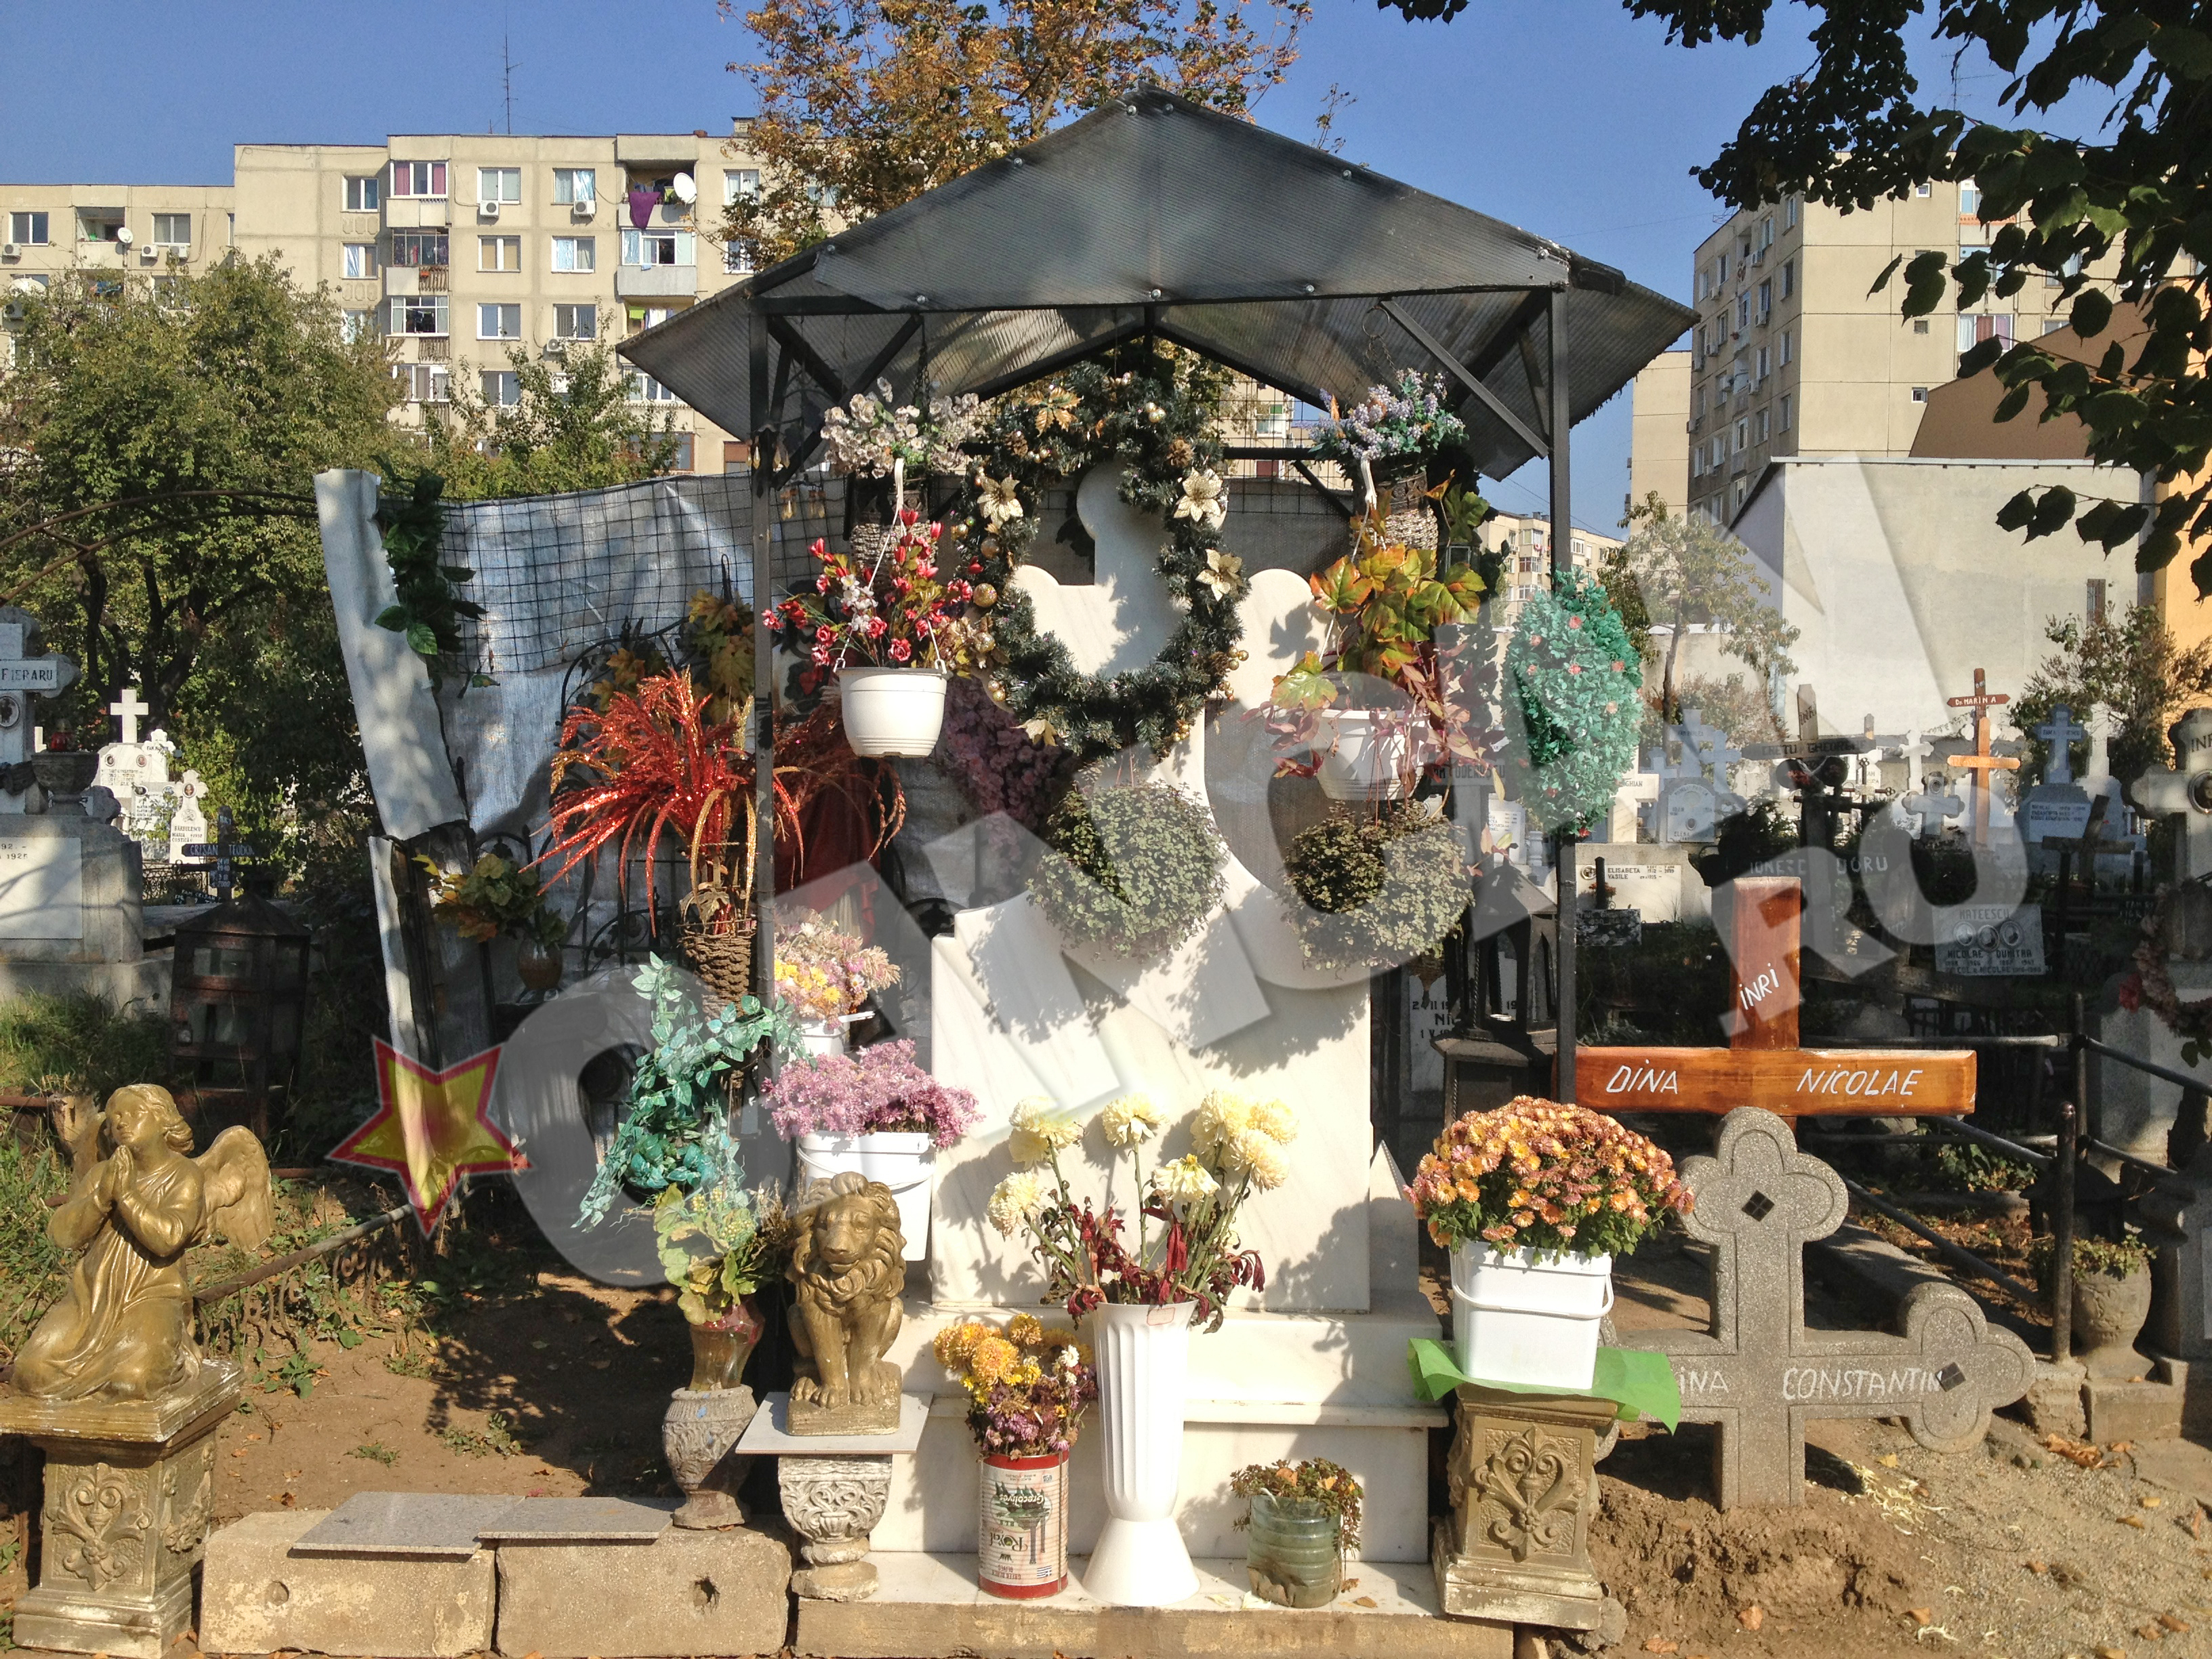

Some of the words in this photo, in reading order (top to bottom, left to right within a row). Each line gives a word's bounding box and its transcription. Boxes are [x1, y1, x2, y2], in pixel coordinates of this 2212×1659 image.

[1, 668, 53, 681] FIERARU
[1959, 909, 2009, 920] MATEESCU
[1948, 949, 1984, 959] NICOLAE
[1605, 1059, 1679, 1094] DINA
[1796, 1063, 1923, 1096] NICOLAE
[1679, 1366, 1729, 1394] INA
[1782, 1366, 1943, 1401] CONSTANTIN
[999, 1494, 1044, 1507] Grecolives
[989, 1532, 1028, 1552] Royal
